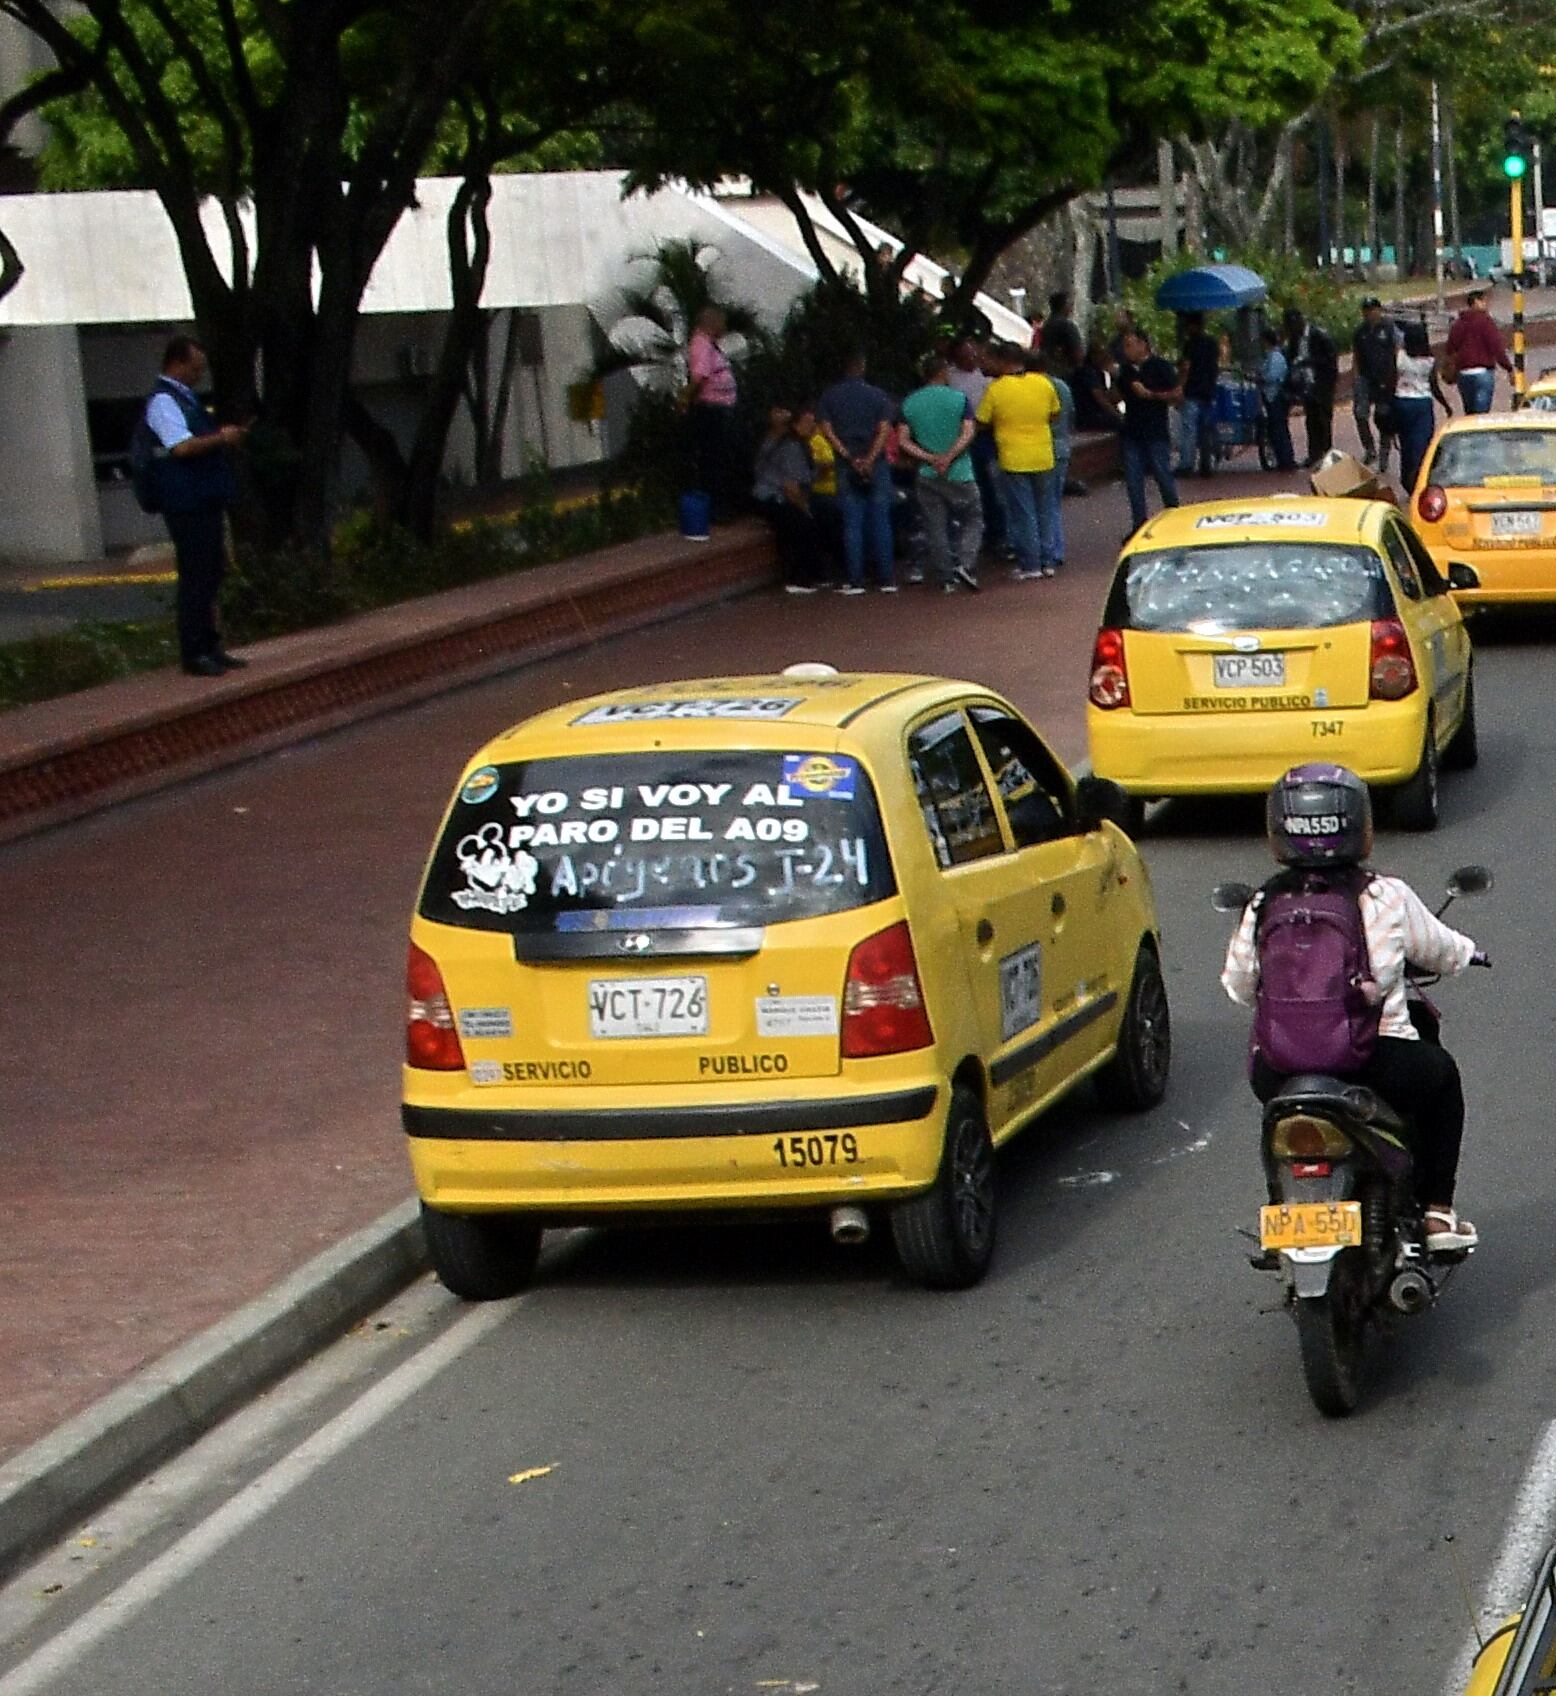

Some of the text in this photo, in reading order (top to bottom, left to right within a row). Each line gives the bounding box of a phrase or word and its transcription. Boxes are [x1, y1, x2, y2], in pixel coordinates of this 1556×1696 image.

[1184, 695, 1311, 711] SERVICIO PUBLICO
[1311, 720, 1344, 737] 7347
[509, 783, 805, 818] YO SI VOY AL
[508, 817, 809, 849] PARO DEL A09
[503, 1060, 592, 1081] SERVICIO
[700, 1054, 788, 1075] PUBLICO
[774, 1133, 858, 1168] 15079
